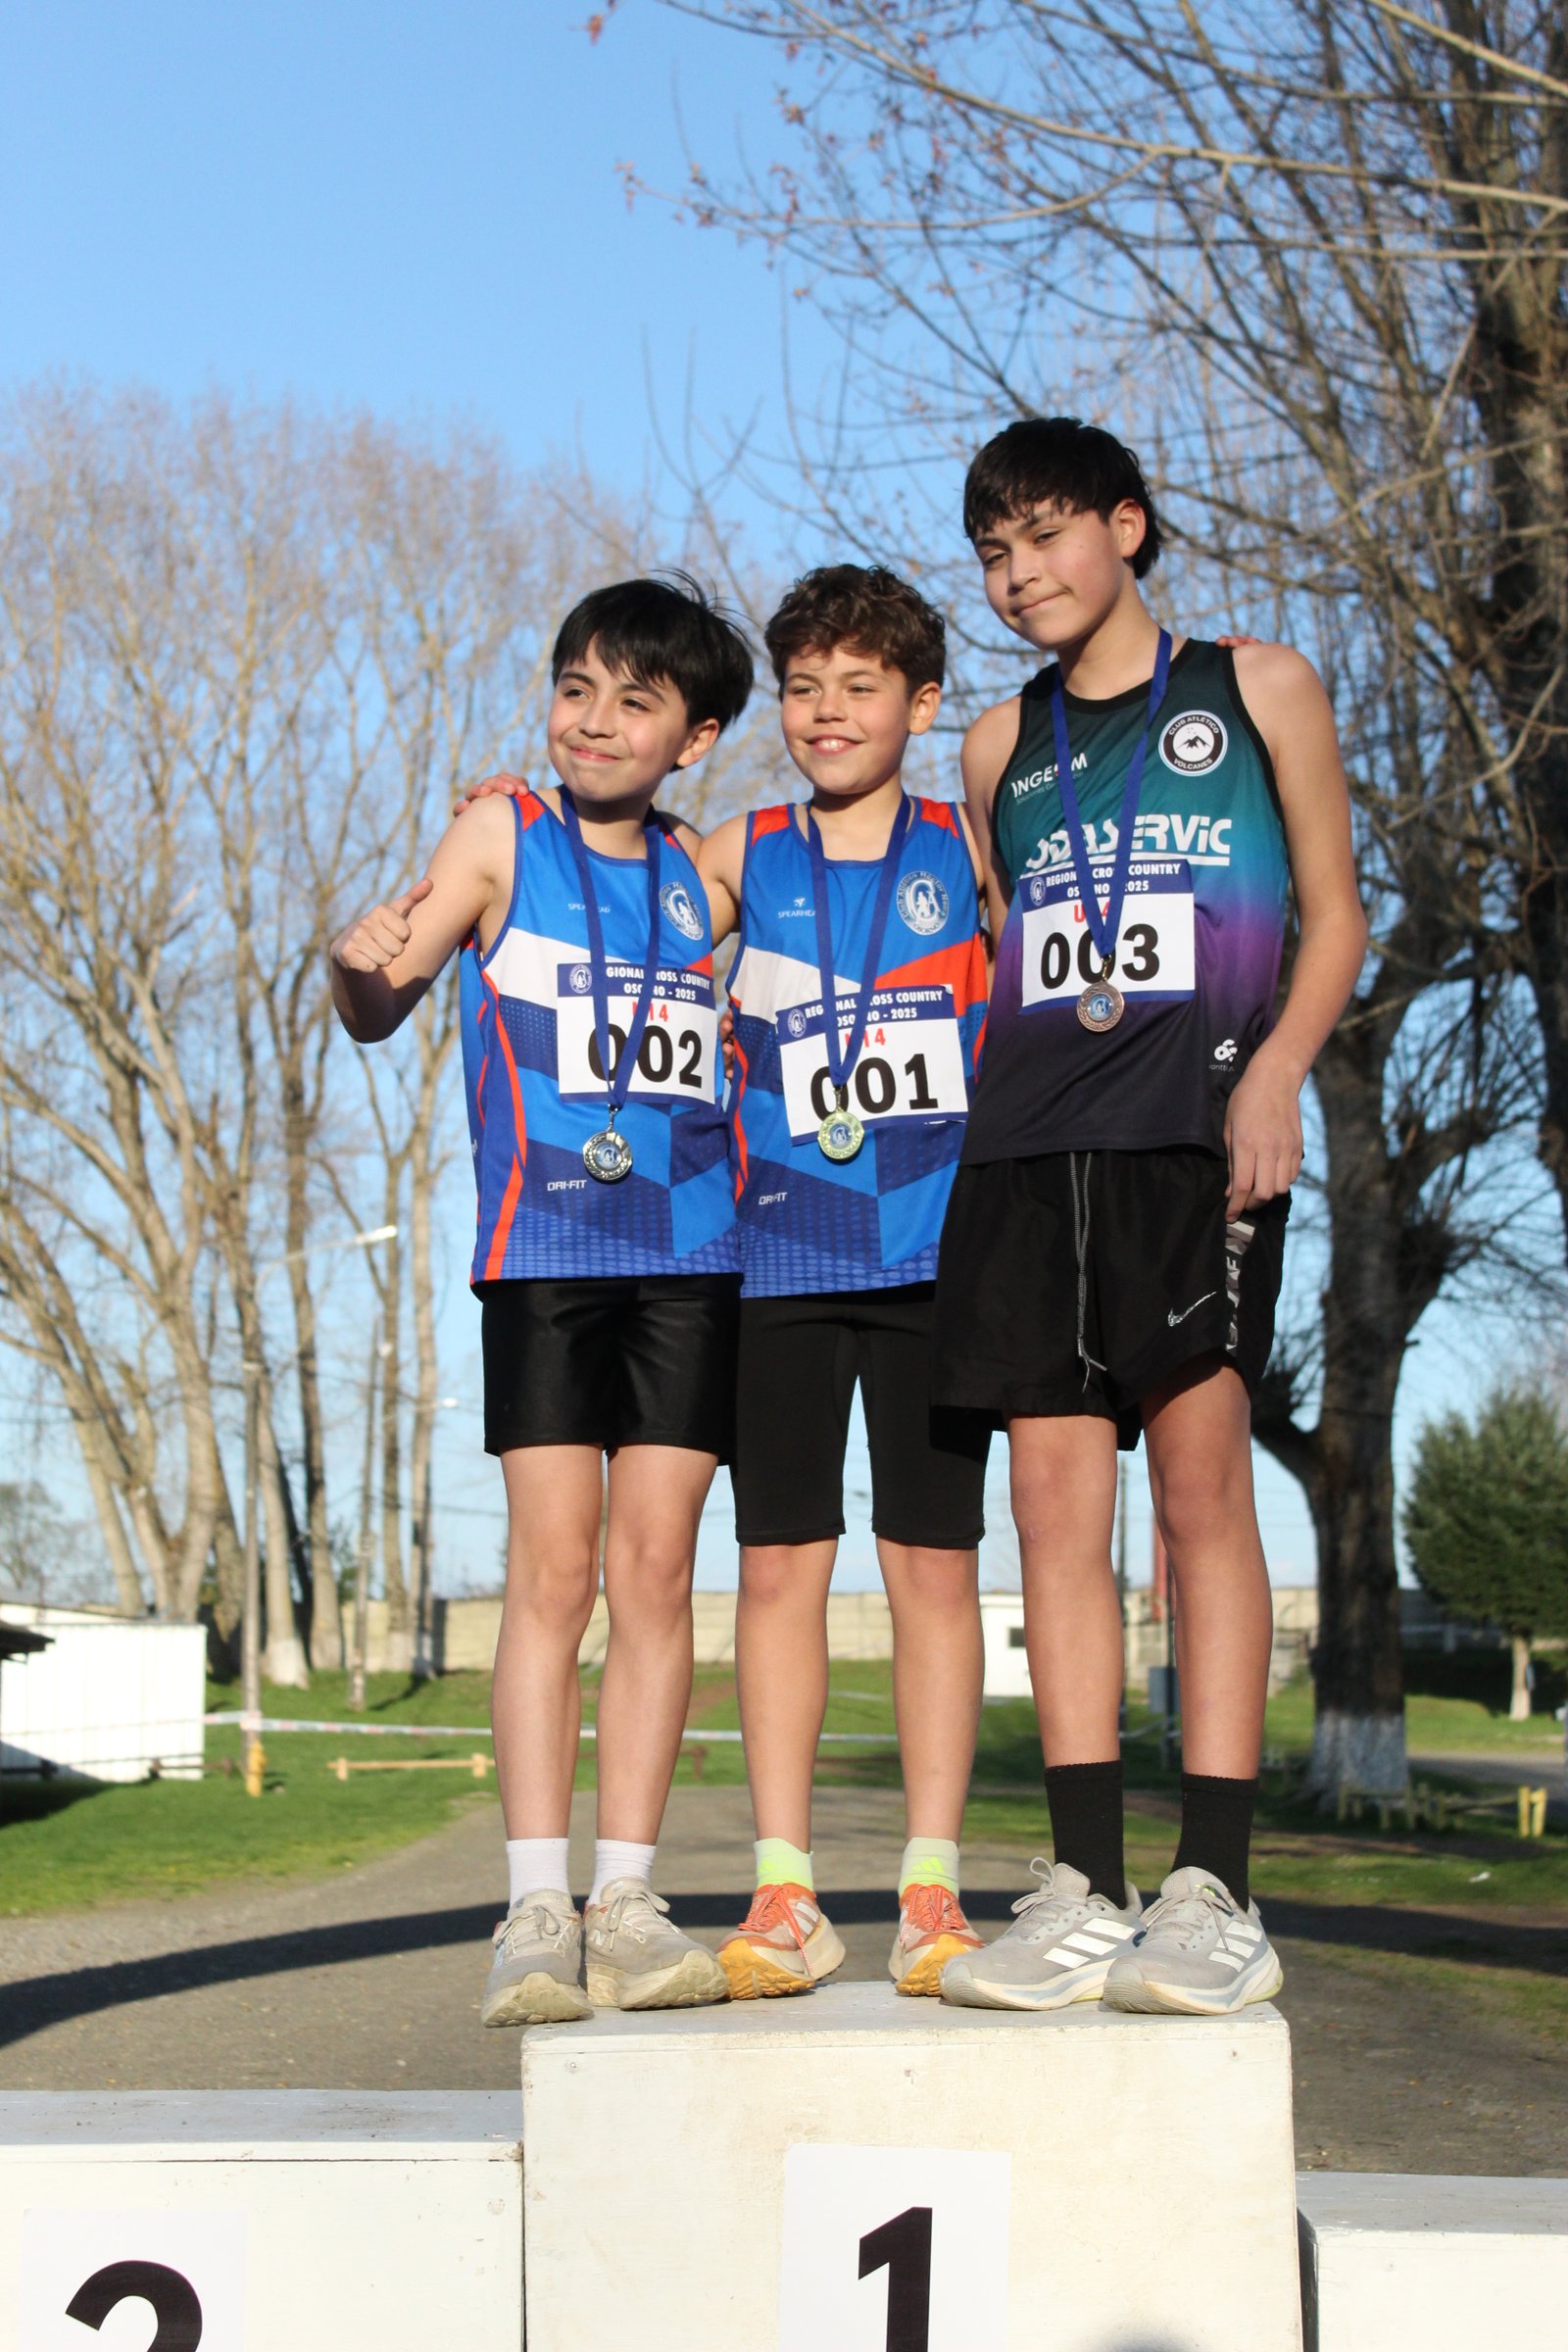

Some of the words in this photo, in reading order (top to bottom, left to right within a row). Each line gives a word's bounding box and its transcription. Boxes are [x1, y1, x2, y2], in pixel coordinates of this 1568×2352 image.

[1168, 719, 1187, 736] CLUB
[1173, 758, 1213, 770] VOLCANES
[1046, 871, 1077, 888] REGION
[1092, 867, 1115, 879] CRO
[1128, 863, 1181, 876] COUNTRY
[1067, 883, 1110, 898] OSNO
[1124, 881, 1150, 892] 025
[1041, 923, 1160, 990] 003
[680, 973, 710, 991] COUNTRY
[674, 988, 696, 1001] 2025
[805, 999, 857, 1019] REGNAL
[869, 992, 894, 1006] OSS
[896, 990, 943, 1003] COUNTRY
[891, 1007, 917, 1020] 2025
[588, 1023, 702, 1089] 002
[810, 1054, 939, 1122] 001
[858, 2206, 933, 2352] 1
